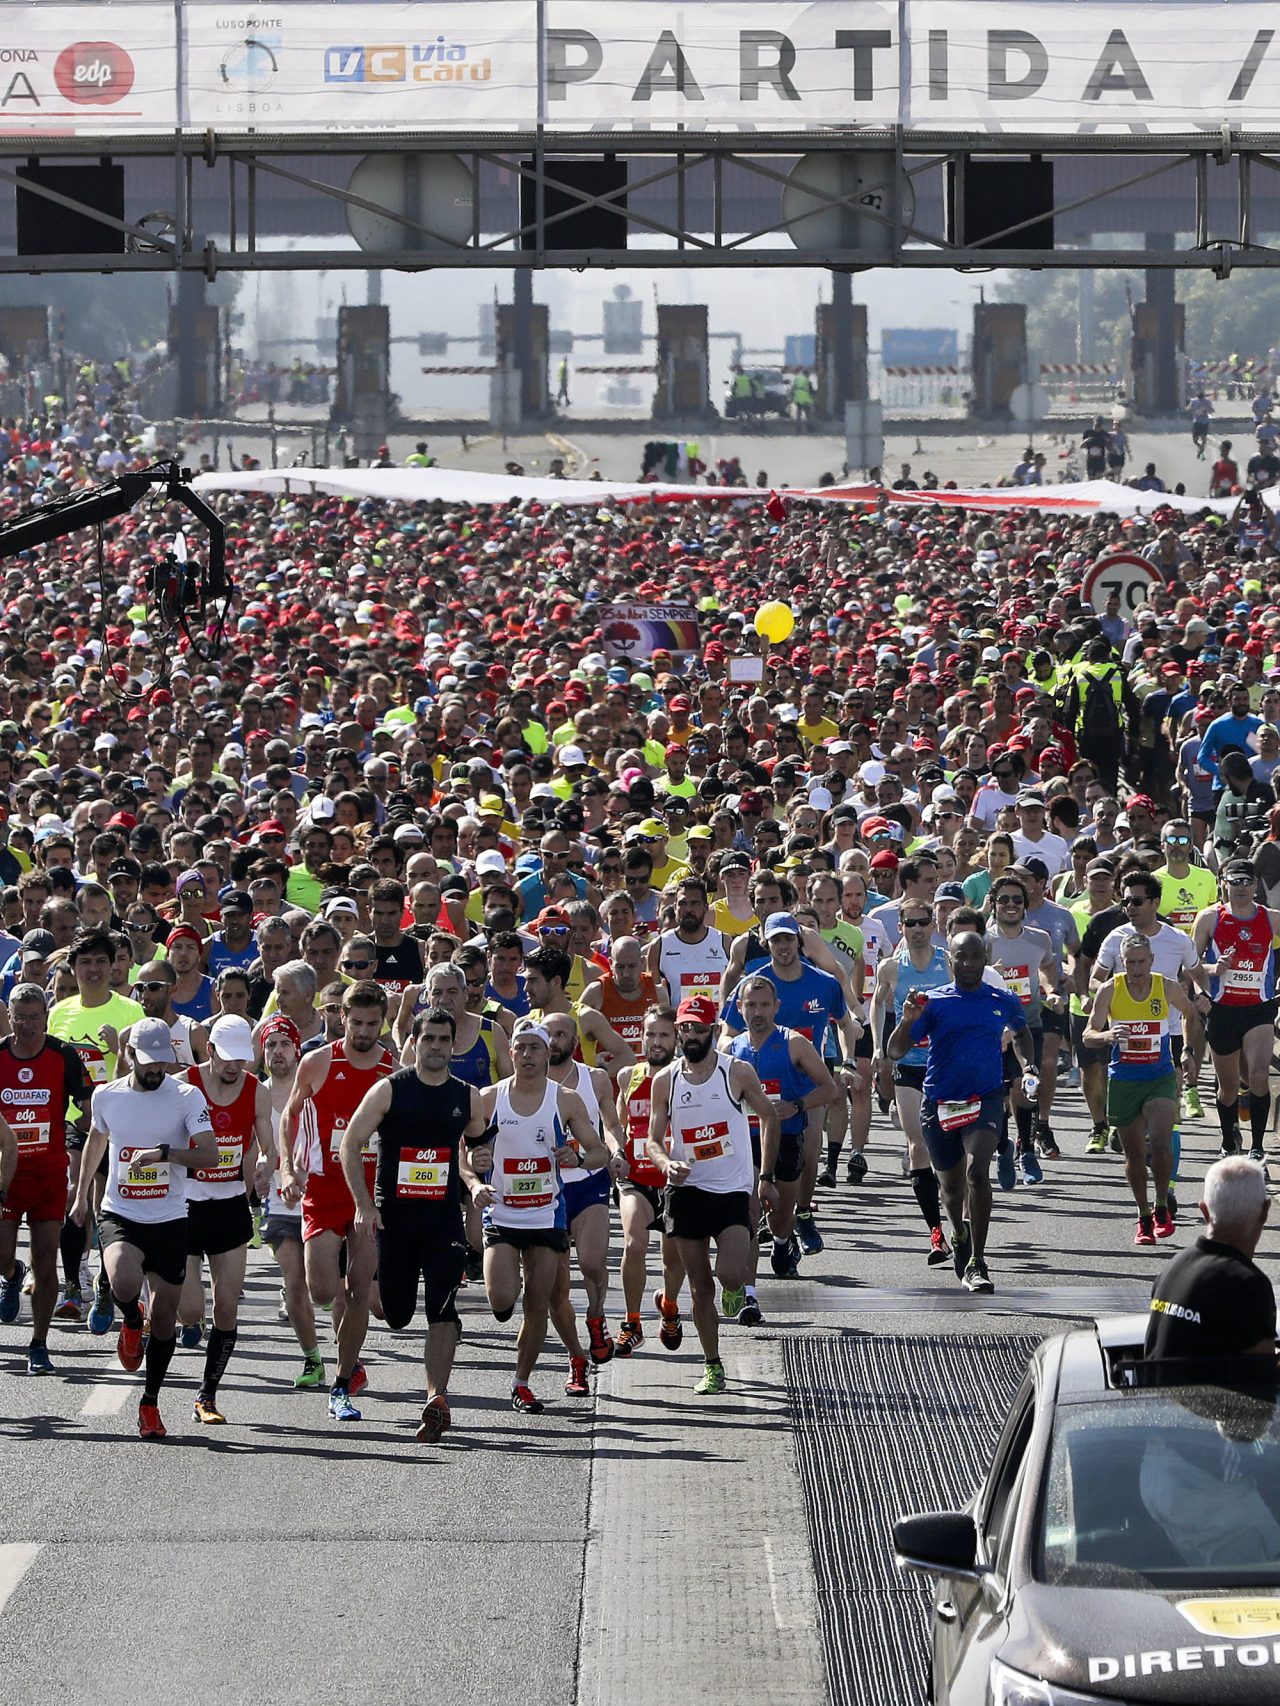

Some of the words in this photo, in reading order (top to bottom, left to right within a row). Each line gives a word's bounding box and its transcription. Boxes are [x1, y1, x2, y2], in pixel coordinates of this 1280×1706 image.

[216, 19, 283, 29] LUSOPONTE
[412, 35, 467, 62] via
[412, 58, 492, 82] card
[545, 28, 1155, 102] PARTIDA
[74, 59, 112, 87] edp
[216, 103, 284, 113] LISBOA
[601, 608, 615, 620] 25
[1237, 958, 1254, 971] edp
[1003, 967, 1019, 979] edp
[1233, 972, 1254, 983] 2955
[692, 973, 710, 986] edp
[384, 980, 401, 993] edp
[621, 1026, 641, 1038] edp
[1131, 1022, 1149, 1035] edp
[14, 1091, 49, 1101] DUAFAR
[15, 1109, 36, 1123] edp
[17, 1131, 34, 1141] 607
[694, 1125, 716, 1141] edp
[415, 1148, 437, 1162] edp
[517, 1158, 538, 1173] edp
[128, 1171, 157, 1182] 19588
[415, 1170, 433, 1181] 260
[407, 1187, 433, 1196] Santander
[517, 1180, 536, 1191] 237
[130, 1187, 169, 1197] vodafone
